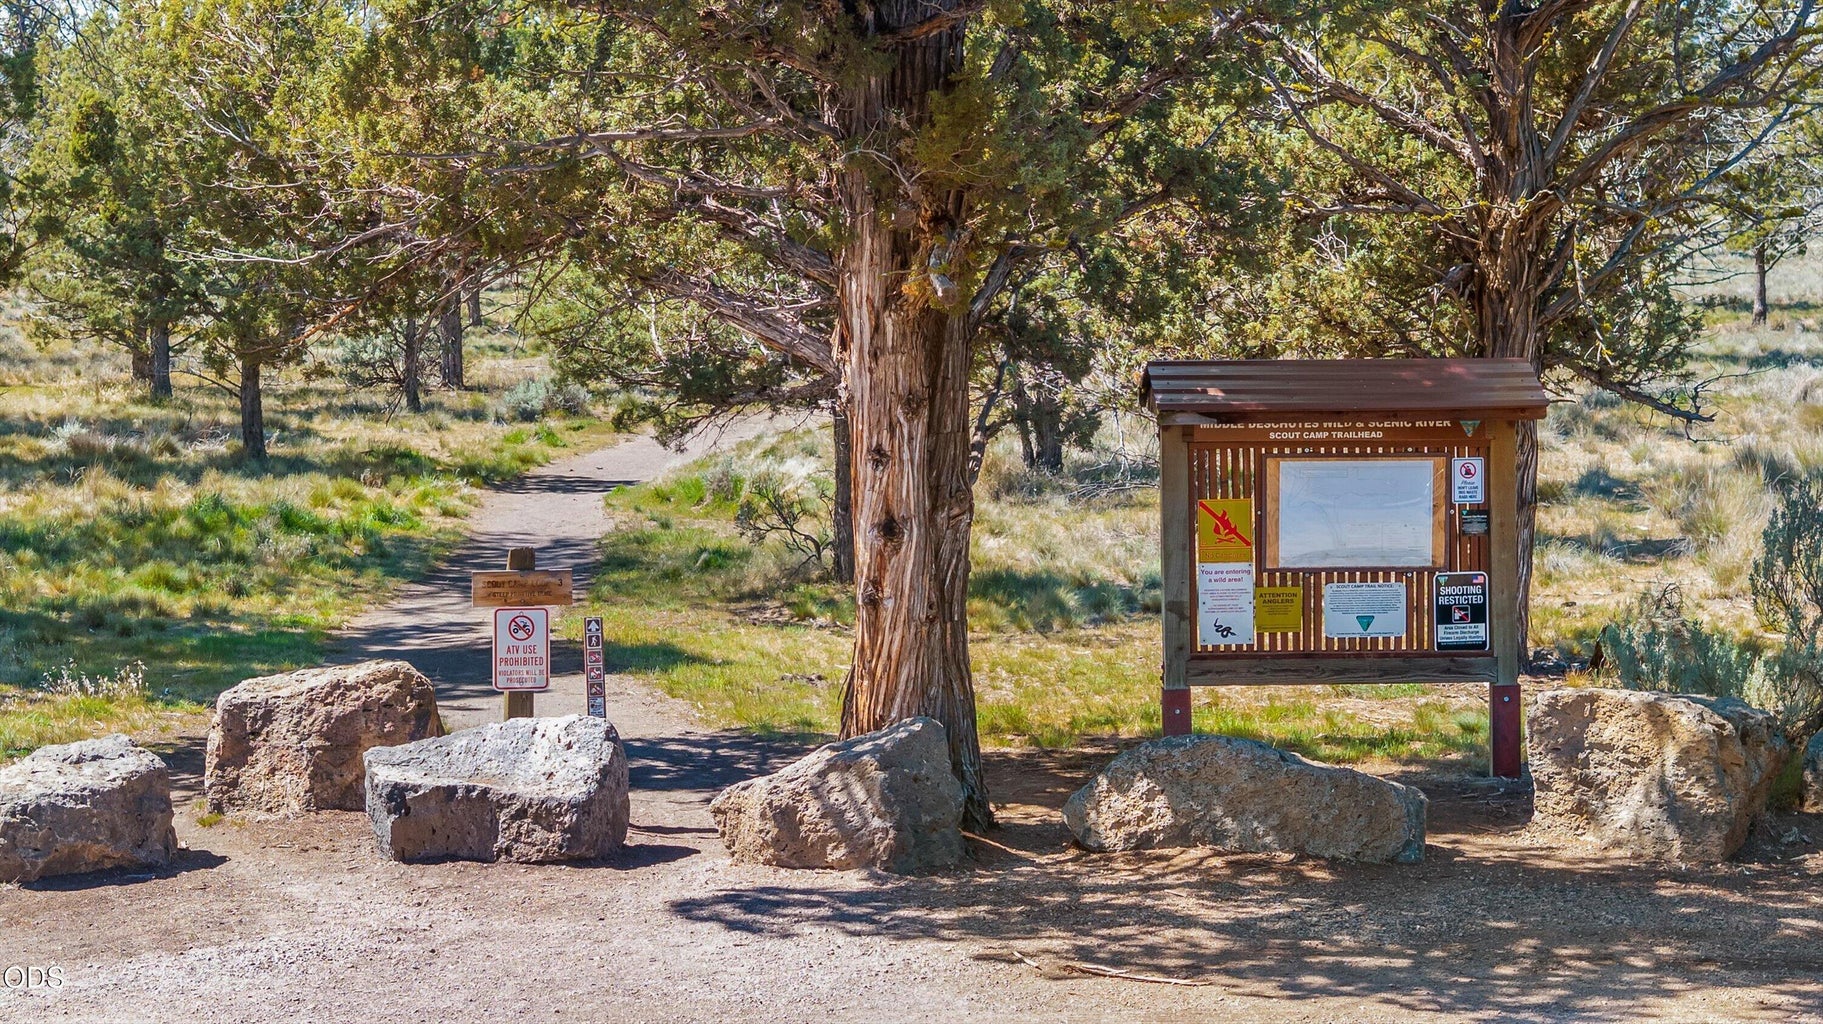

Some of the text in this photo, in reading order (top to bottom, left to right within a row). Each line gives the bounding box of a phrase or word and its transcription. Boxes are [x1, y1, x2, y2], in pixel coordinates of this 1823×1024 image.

[1269, 431, 1383, 439] SCOUT CAMP TRAILHEAD
[558, 578, 563, 587] 3
[1440, 585, 1482, 595] SHOOTING
[1438, 595, 1484, 605] RESTICTED
[506, 644, 537, 655] ATV USE
[499, 656, 544, 666] PROHIBITED
[506, 676, 537, 684] PROSECUTED
